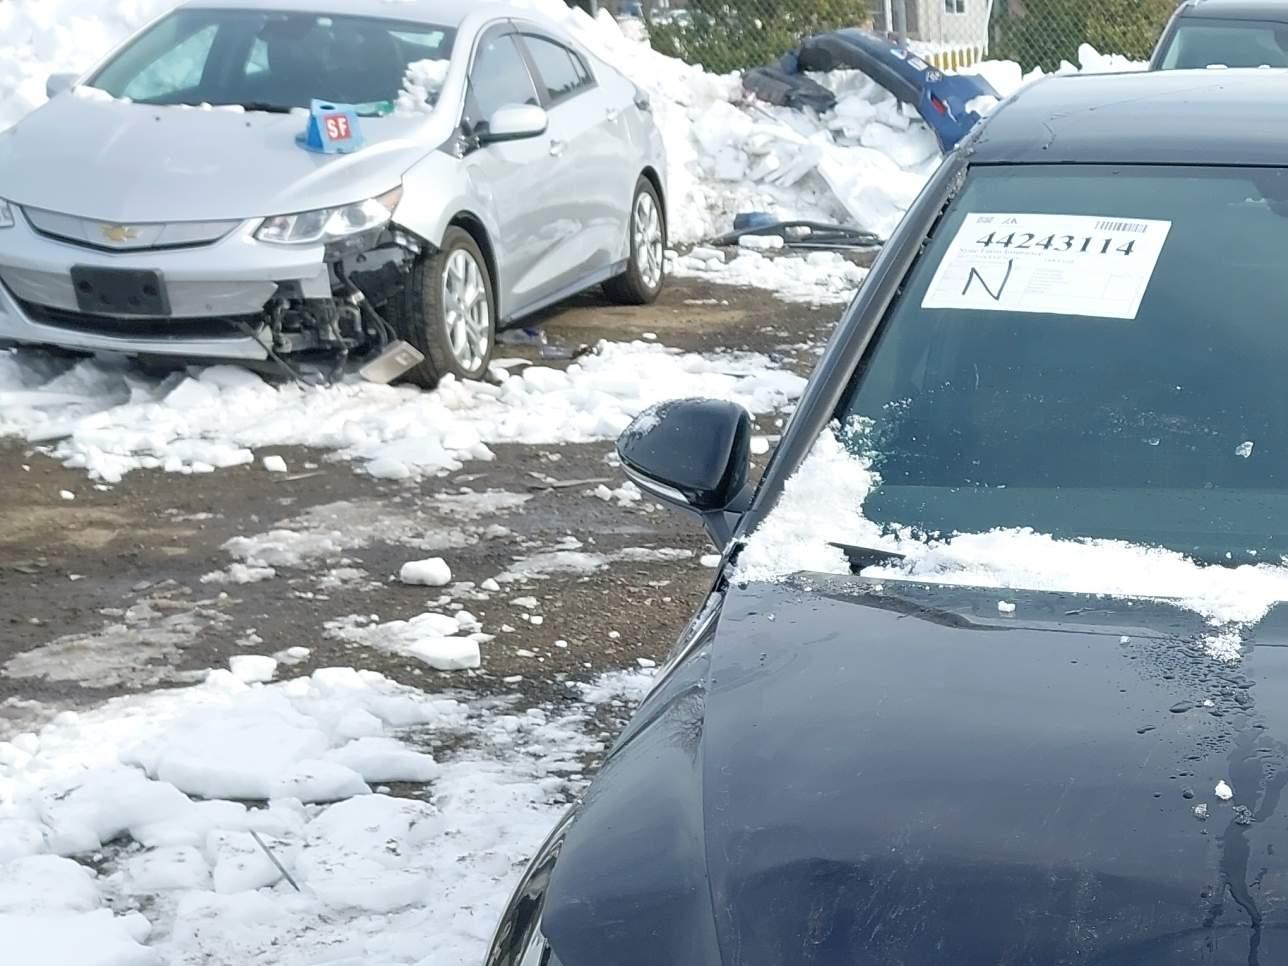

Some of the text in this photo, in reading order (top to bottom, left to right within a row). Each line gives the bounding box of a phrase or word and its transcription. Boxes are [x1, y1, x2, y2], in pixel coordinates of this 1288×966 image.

[326, 117, 348, 139] SF
[975, 231, 1136, 256] 44243114
[961, 258, 1014, 301] N
